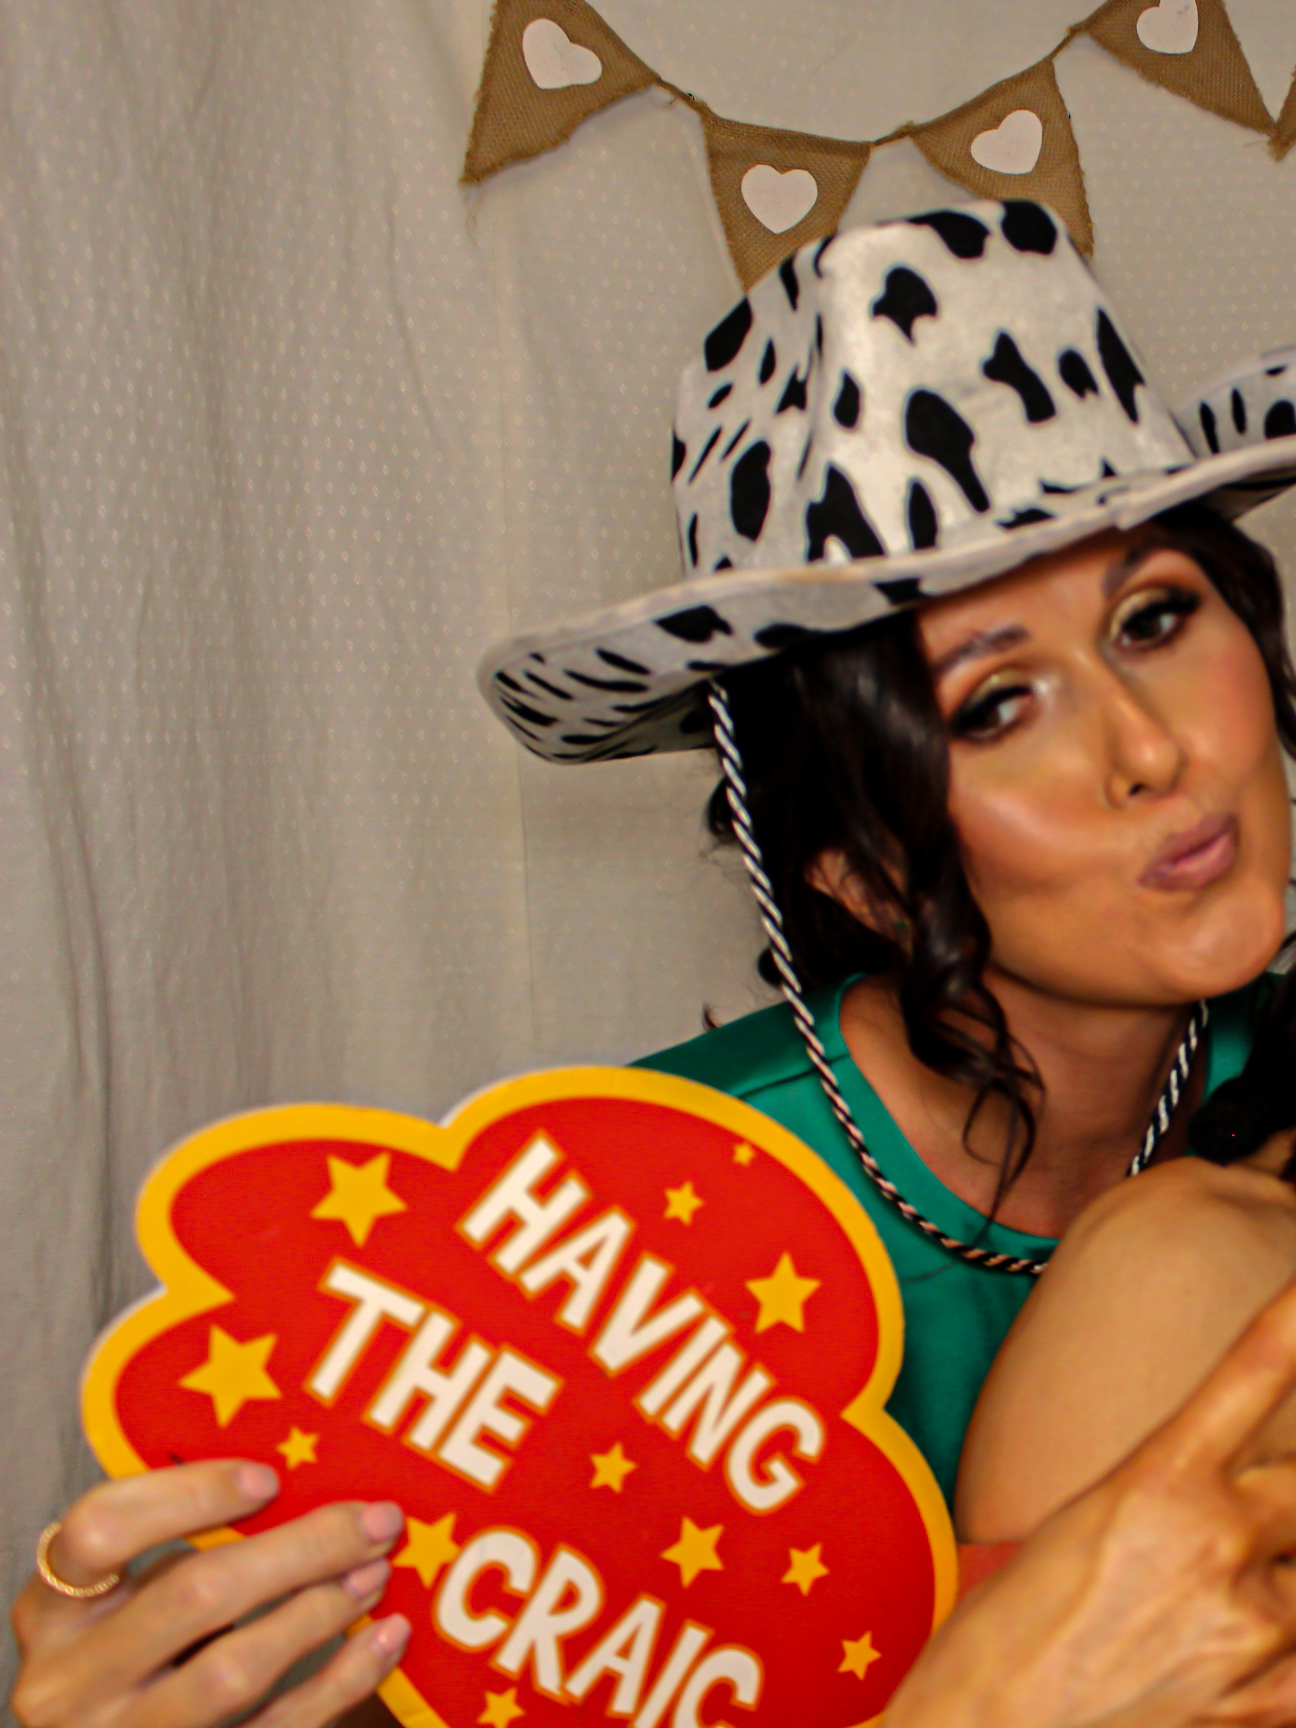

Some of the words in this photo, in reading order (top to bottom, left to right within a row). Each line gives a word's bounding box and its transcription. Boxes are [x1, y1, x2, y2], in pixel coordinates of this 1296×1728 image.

[309, 1262, 560, 1488] THE
[461, 1134, 825, 1512] HAVING
[434, 1529, 763, 1728] CRAIC
